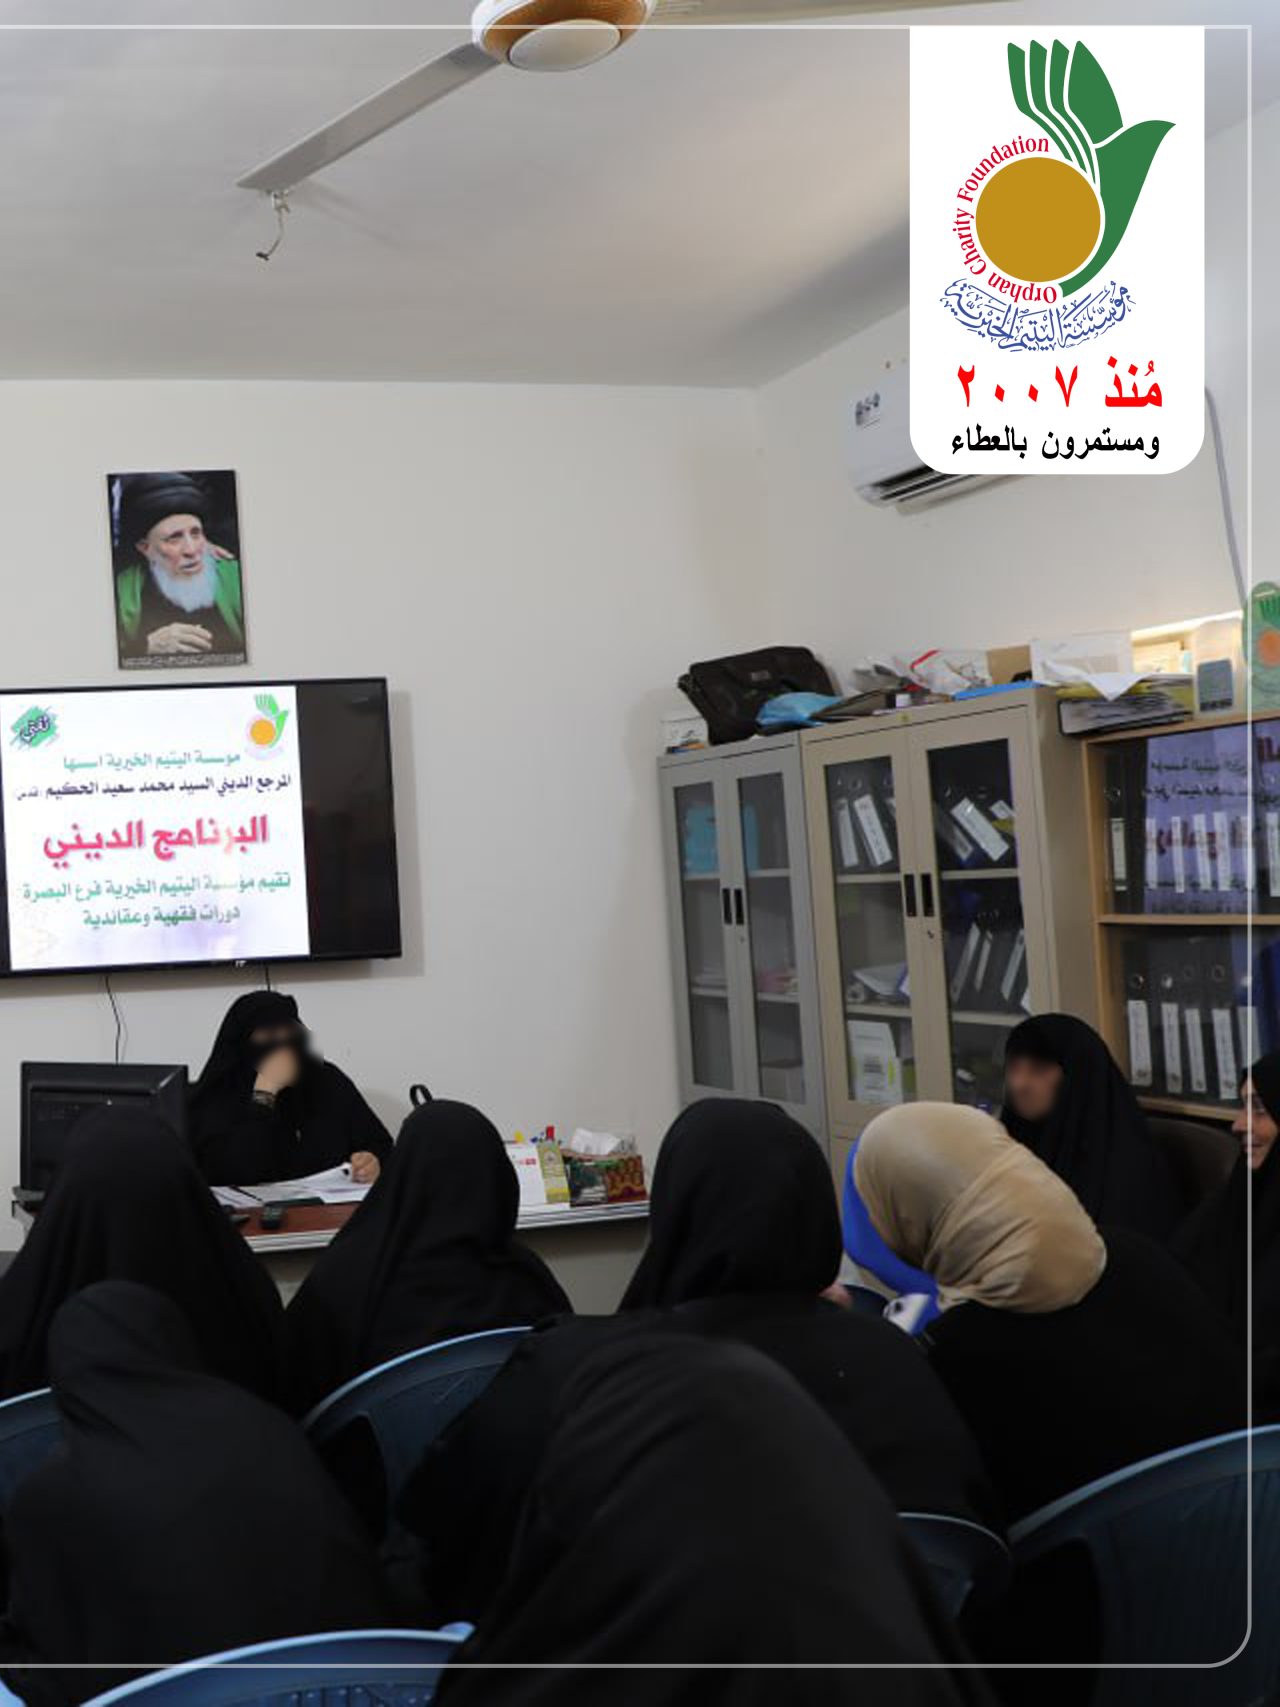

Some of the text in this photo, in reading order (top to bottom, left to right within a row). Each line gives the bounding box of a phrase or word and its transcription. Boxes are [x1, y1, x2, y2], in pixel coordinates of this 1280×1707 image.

[106, 753, 153, 772] الخيرية
[155, 750, 191, 770] اليتيم
[46, 780, 99, 799] الحكيم
[102, 783, 135, 797] سعيد
[139, 780, 175, 794] محمد
[179, 776, 215, 795] السيد
[216, 775, 253, 797] الديني
[256, 773, 291, 793] المرجع
[42, 813, 269, 870] البرنامج الديني
[22, 882, 72, 903] البصرة
[75, 880, 103, 902] فرع
[106, 878, 156, 899] الخيرية
[159, 876, 200, 897] اليتيم
[258, 871, 291, 894] تقيم
[152, 905, 197, 927] فقهية
[199, 903, 241, 924] دورات
